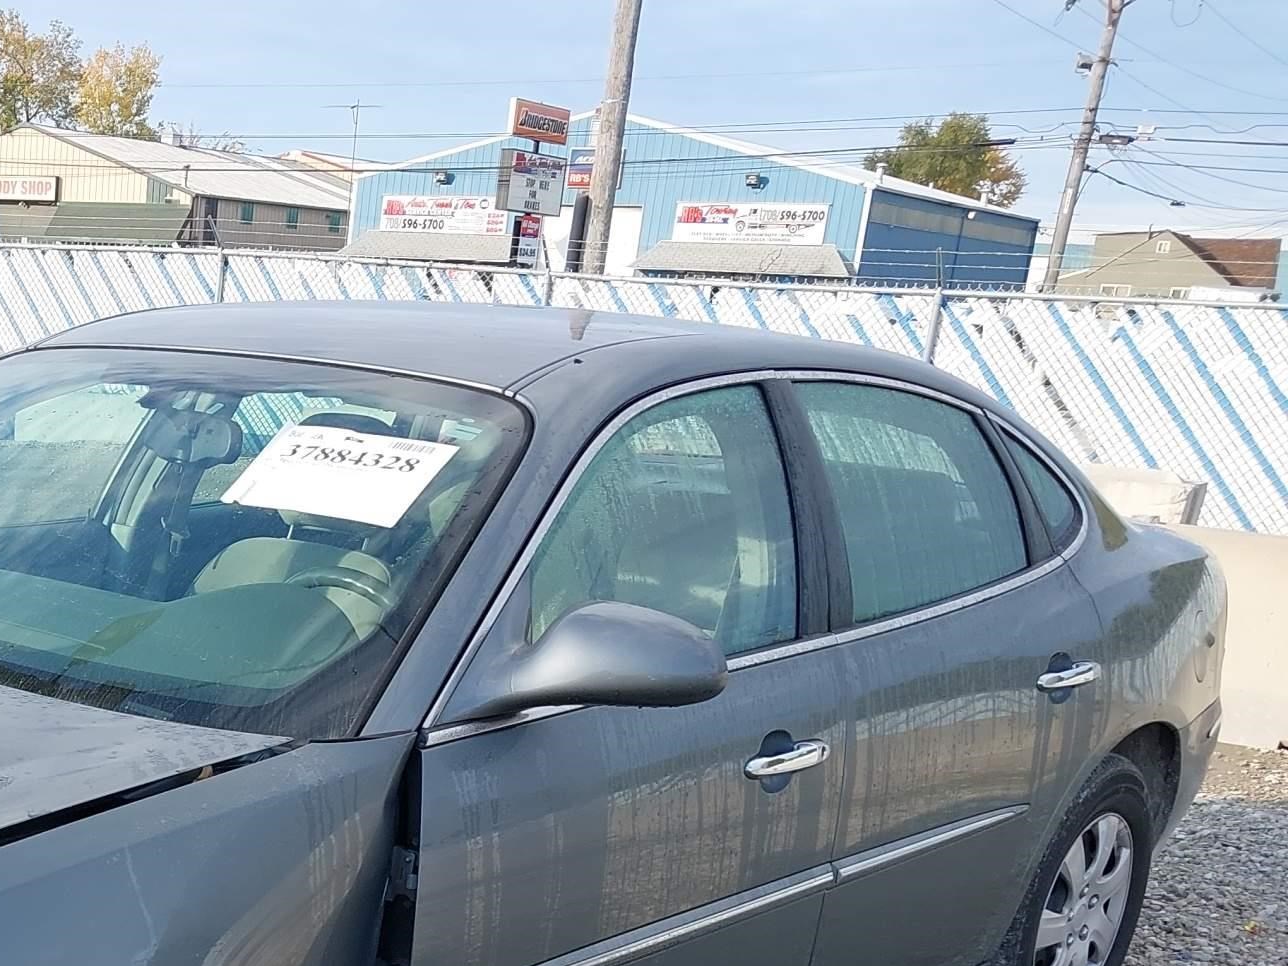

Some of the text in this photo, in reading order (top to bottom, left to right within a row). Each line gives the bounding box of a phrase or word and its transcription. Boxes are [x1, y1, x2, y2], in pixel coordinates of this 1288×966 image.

[519, 108, 567, 135] BRIDGESTONE
[21, 181, 52, 195] SHOP
[279, 444, 422, 473] 37884328
